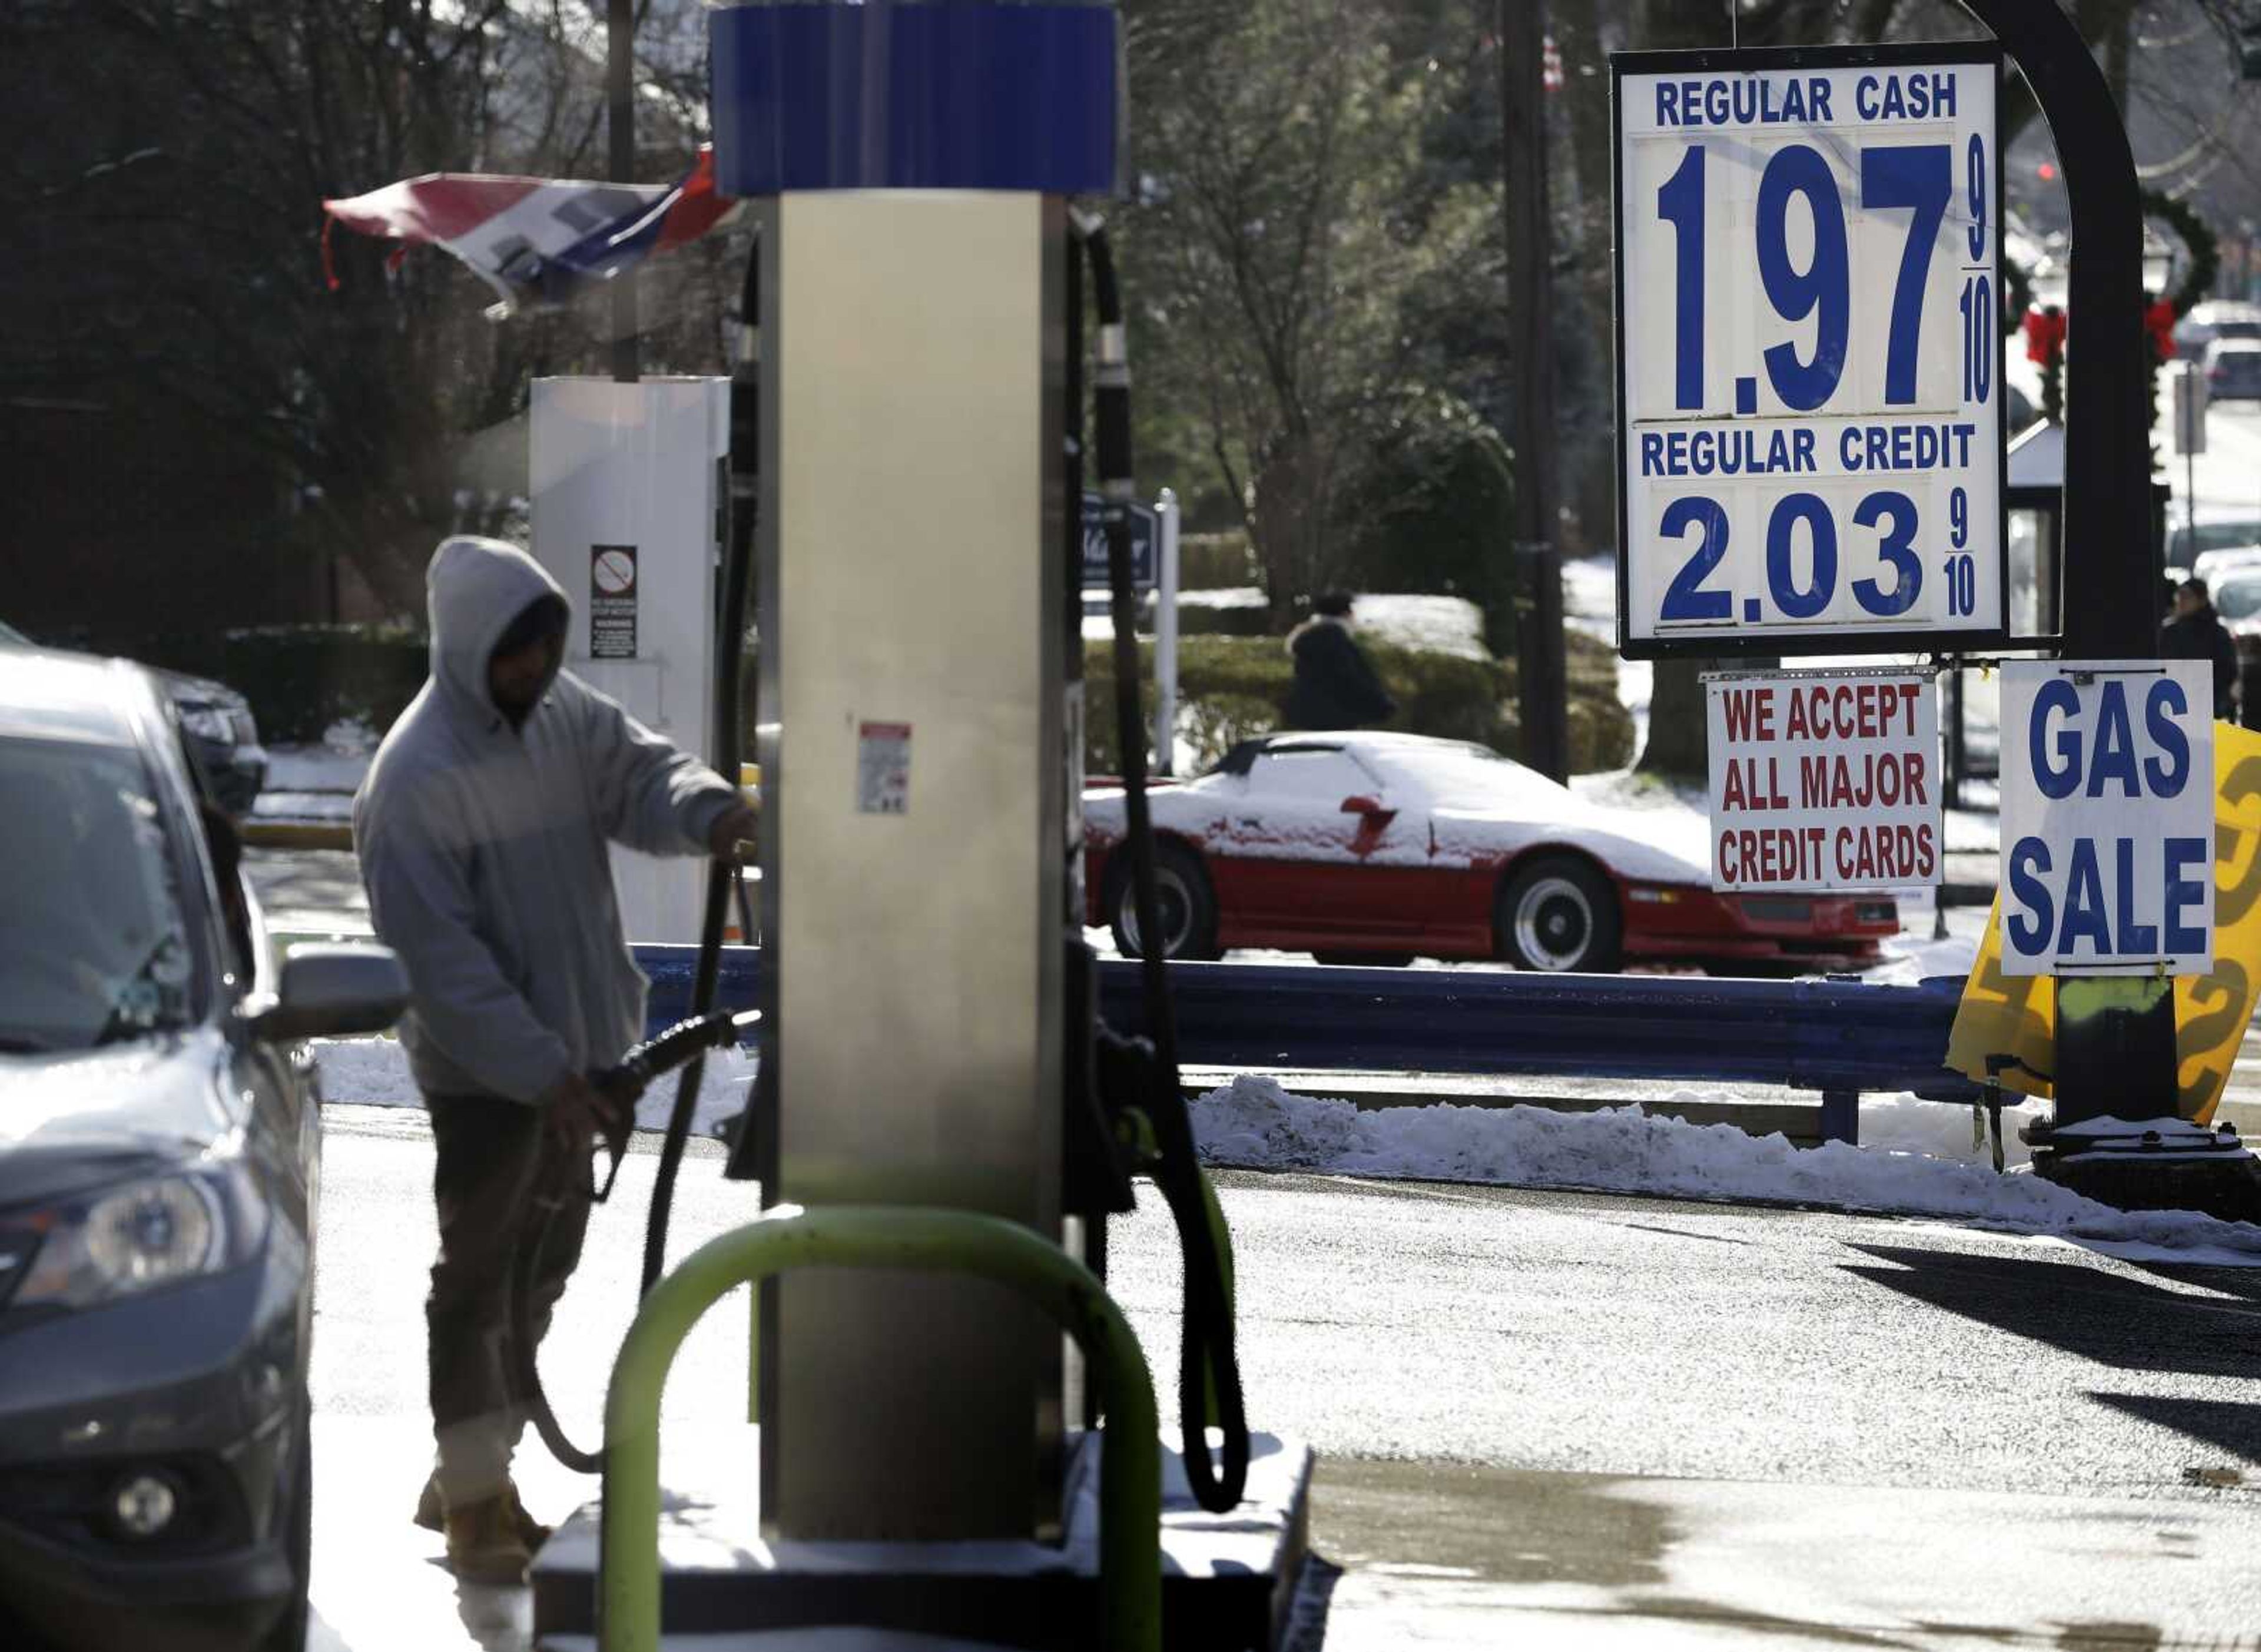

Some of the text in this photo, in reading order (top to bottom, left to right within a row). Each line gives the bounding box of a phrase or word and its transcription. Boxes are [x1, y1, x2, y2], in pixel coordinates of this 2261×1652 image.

[1656, 73, 1957, 127] REGULAR CASH
[1967, 133, 1987, 263] 9
[1657, 143, 1953, 415] 1.97
[1959, 275, 1991, 405] 10
[1641, 423, 1976, 477] REGULAR CREDIT
[1950, 486, 1968, 549] 9
[1659, 490, 1924, 623] 2.03
[1943, 553, 1975, 617] 10
[1723, 683, 1922, 743] WE ACCEPT
[2028, 678, 2191, 801] GAS
[1722, 752, 1927, 811] ALL MAJOR
[1719, 822, 1935, 884] CREDIT CARDS
[2007, 835, 2209, 957] SALE
